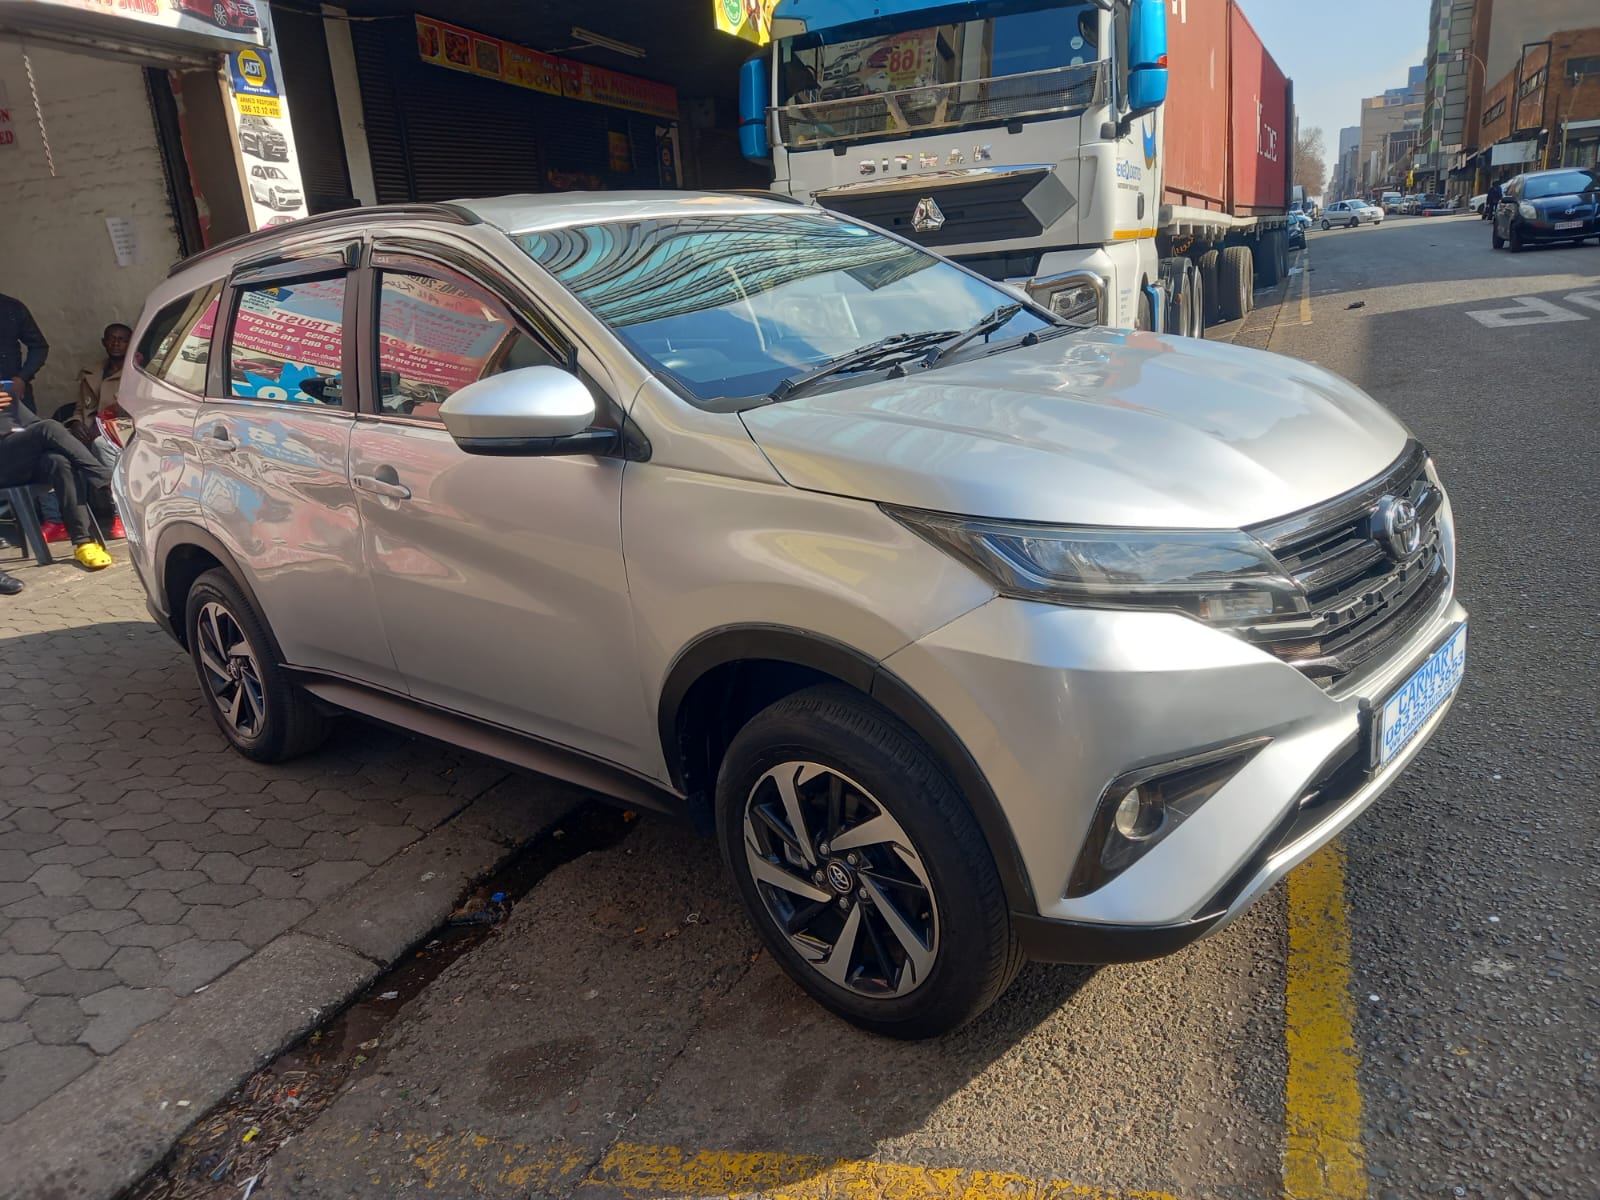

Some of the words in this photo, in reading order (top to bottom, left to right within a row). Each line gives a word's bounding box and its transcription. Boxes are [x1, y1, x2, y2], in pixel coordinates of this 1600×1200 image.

[245, 61, 262, 75] ADT
[1397, 638, 1457, 715] CARMART
[1385, 710, 1411, 747] 083
[1413, 682, 1436, 714] 533
